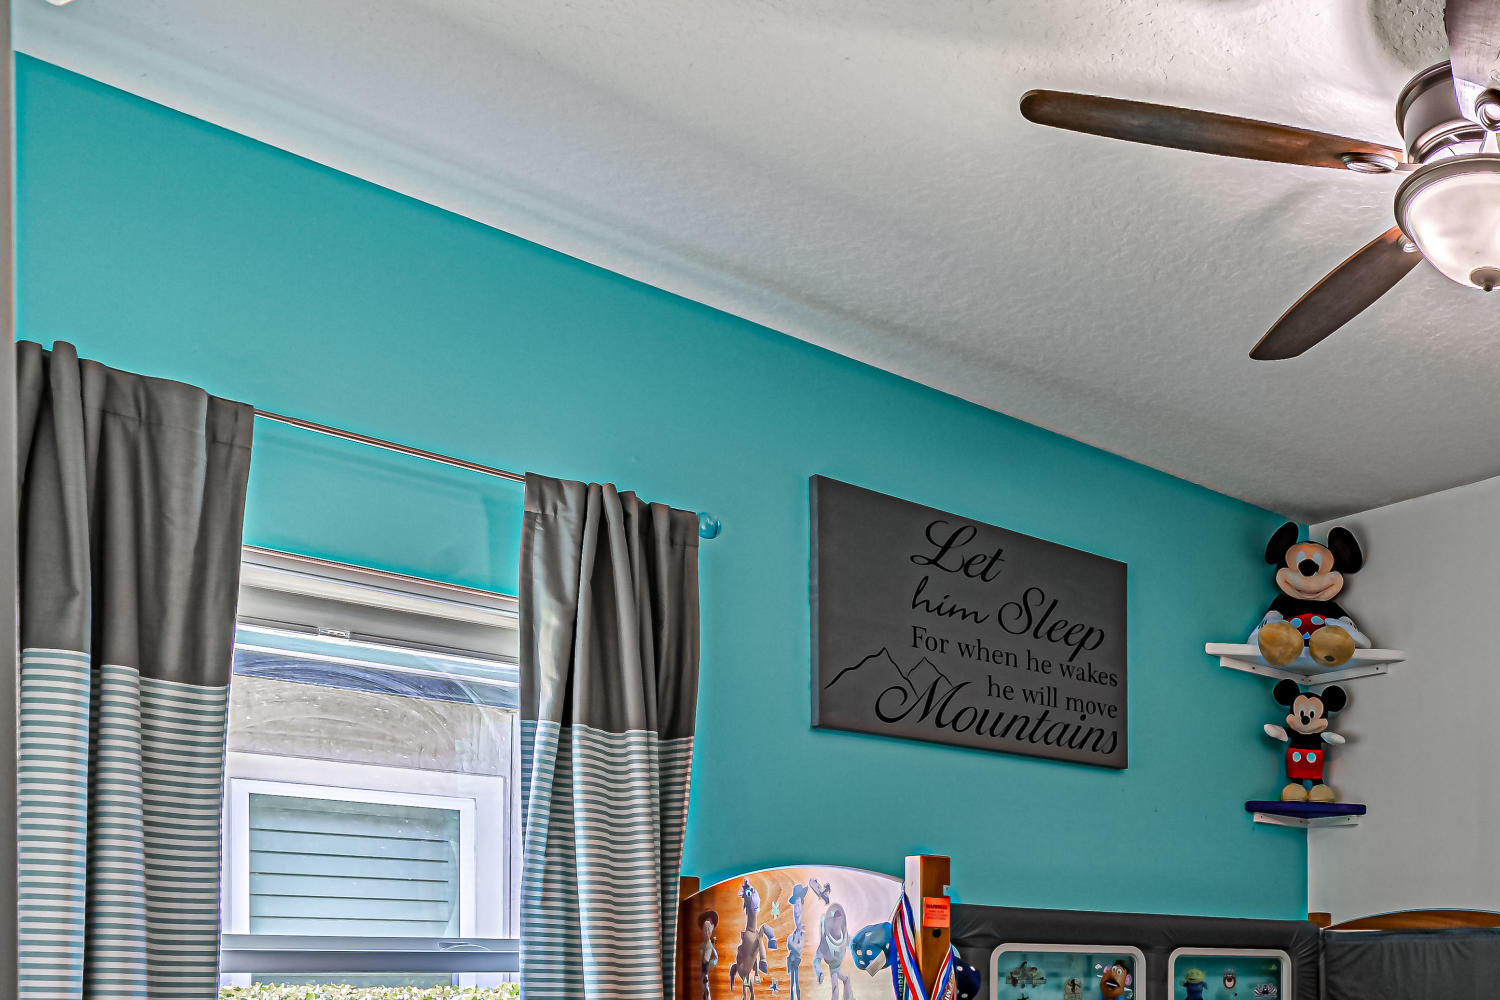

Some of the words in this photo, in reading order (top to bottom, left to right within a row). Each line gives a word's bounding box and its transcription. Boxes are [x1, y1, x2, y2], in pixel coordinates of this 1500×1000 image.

[910, 520, 1005, 582] Let
[911, 576, 990, 624] him
[997, 587, 1105, 662] Sleep
[911, 626, 949, 653] For
[957, 639, 1018, 668] when
[1026, 649, 1052, 675] he
[1059, 662, 1119, 688] wakes
[875, 675, 1119, 755] Mountains
[987, 675, 1015, 701] he
[1022, 685, 1058, 709] will
[1065, 697, 1119, 719] move
